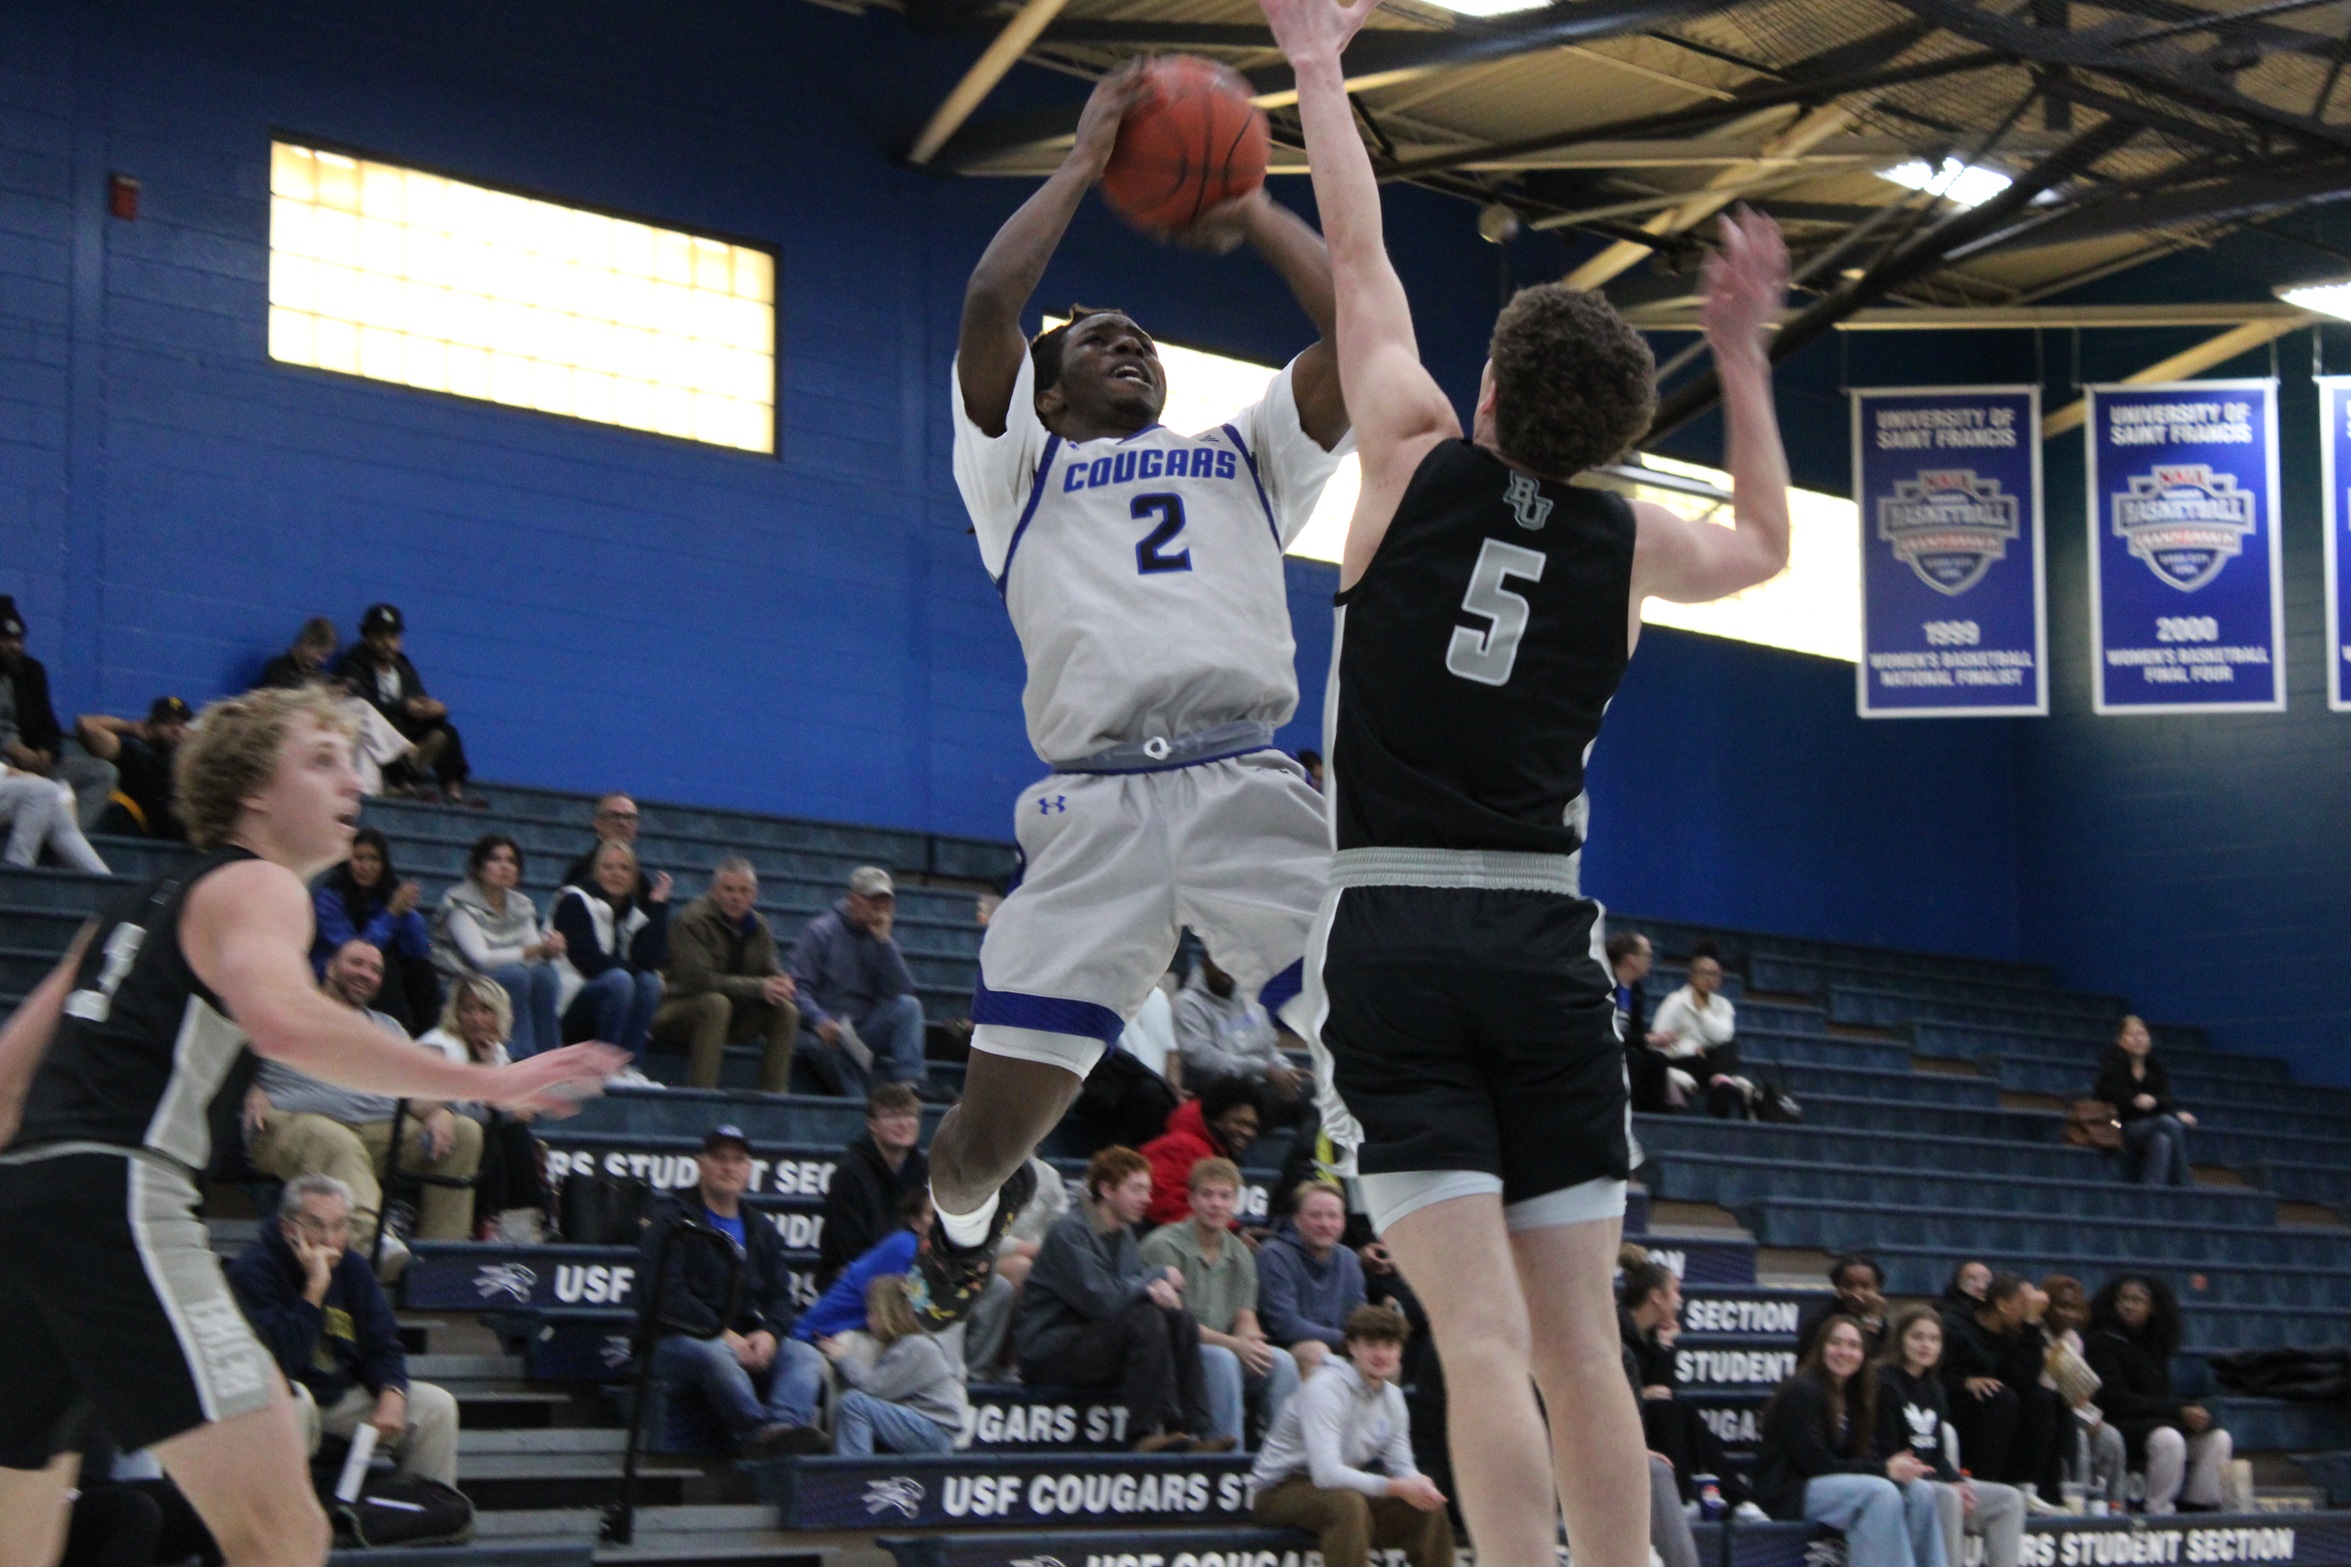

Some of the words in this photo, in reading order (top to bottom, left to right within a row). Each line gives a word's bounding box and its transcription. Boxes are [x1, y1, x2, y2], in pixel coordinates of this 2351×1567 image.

[1876, 409, 1985, 428] UNIVERSITY
[1989, 408, 2015, 427] OF
[2110, 403, 2221, 424] UNIVERSITY
[2223, 402, 2251, 423] OF
[1876, 429, 1932, 449] SAINT
[1936, 428, 2017, 447] FRANCIS
[2110, 424, 2167, 446] SAINT
[2170, 423, 2253, 444] FRANCIS
[1063, 448, 1236, 493] COUGARS
[1129, 492, 1192, 575] 2
[1445, 537, 1546, 686] 5
[1941, 650, 2033, 667] BASKETBALL
[2178, 646, 2270, 664] BASKETBALL
[1880, 670, 1954, 687] NATIONAL
[1955, 669, 2023, 686] FINALIST
[2144, 666, 2189, 684] FINAL
[604, 1152, 769, 1191] STUDT
[554, 1264, 636, 1304] USF
[1685, 1300, 1799, 1332] SECTION
[1674, 1351, 1798, 1383] STUDENT
[972, 1404, 1077, 1443] GARS
[942, 1474, 1022, 1517] USF
[1028, 1473, 1209, 1515] COUGARS
[2061, 1531, 2183, 1566] STUDENT
[2186, 1528, 2295, 1563] SECTION
